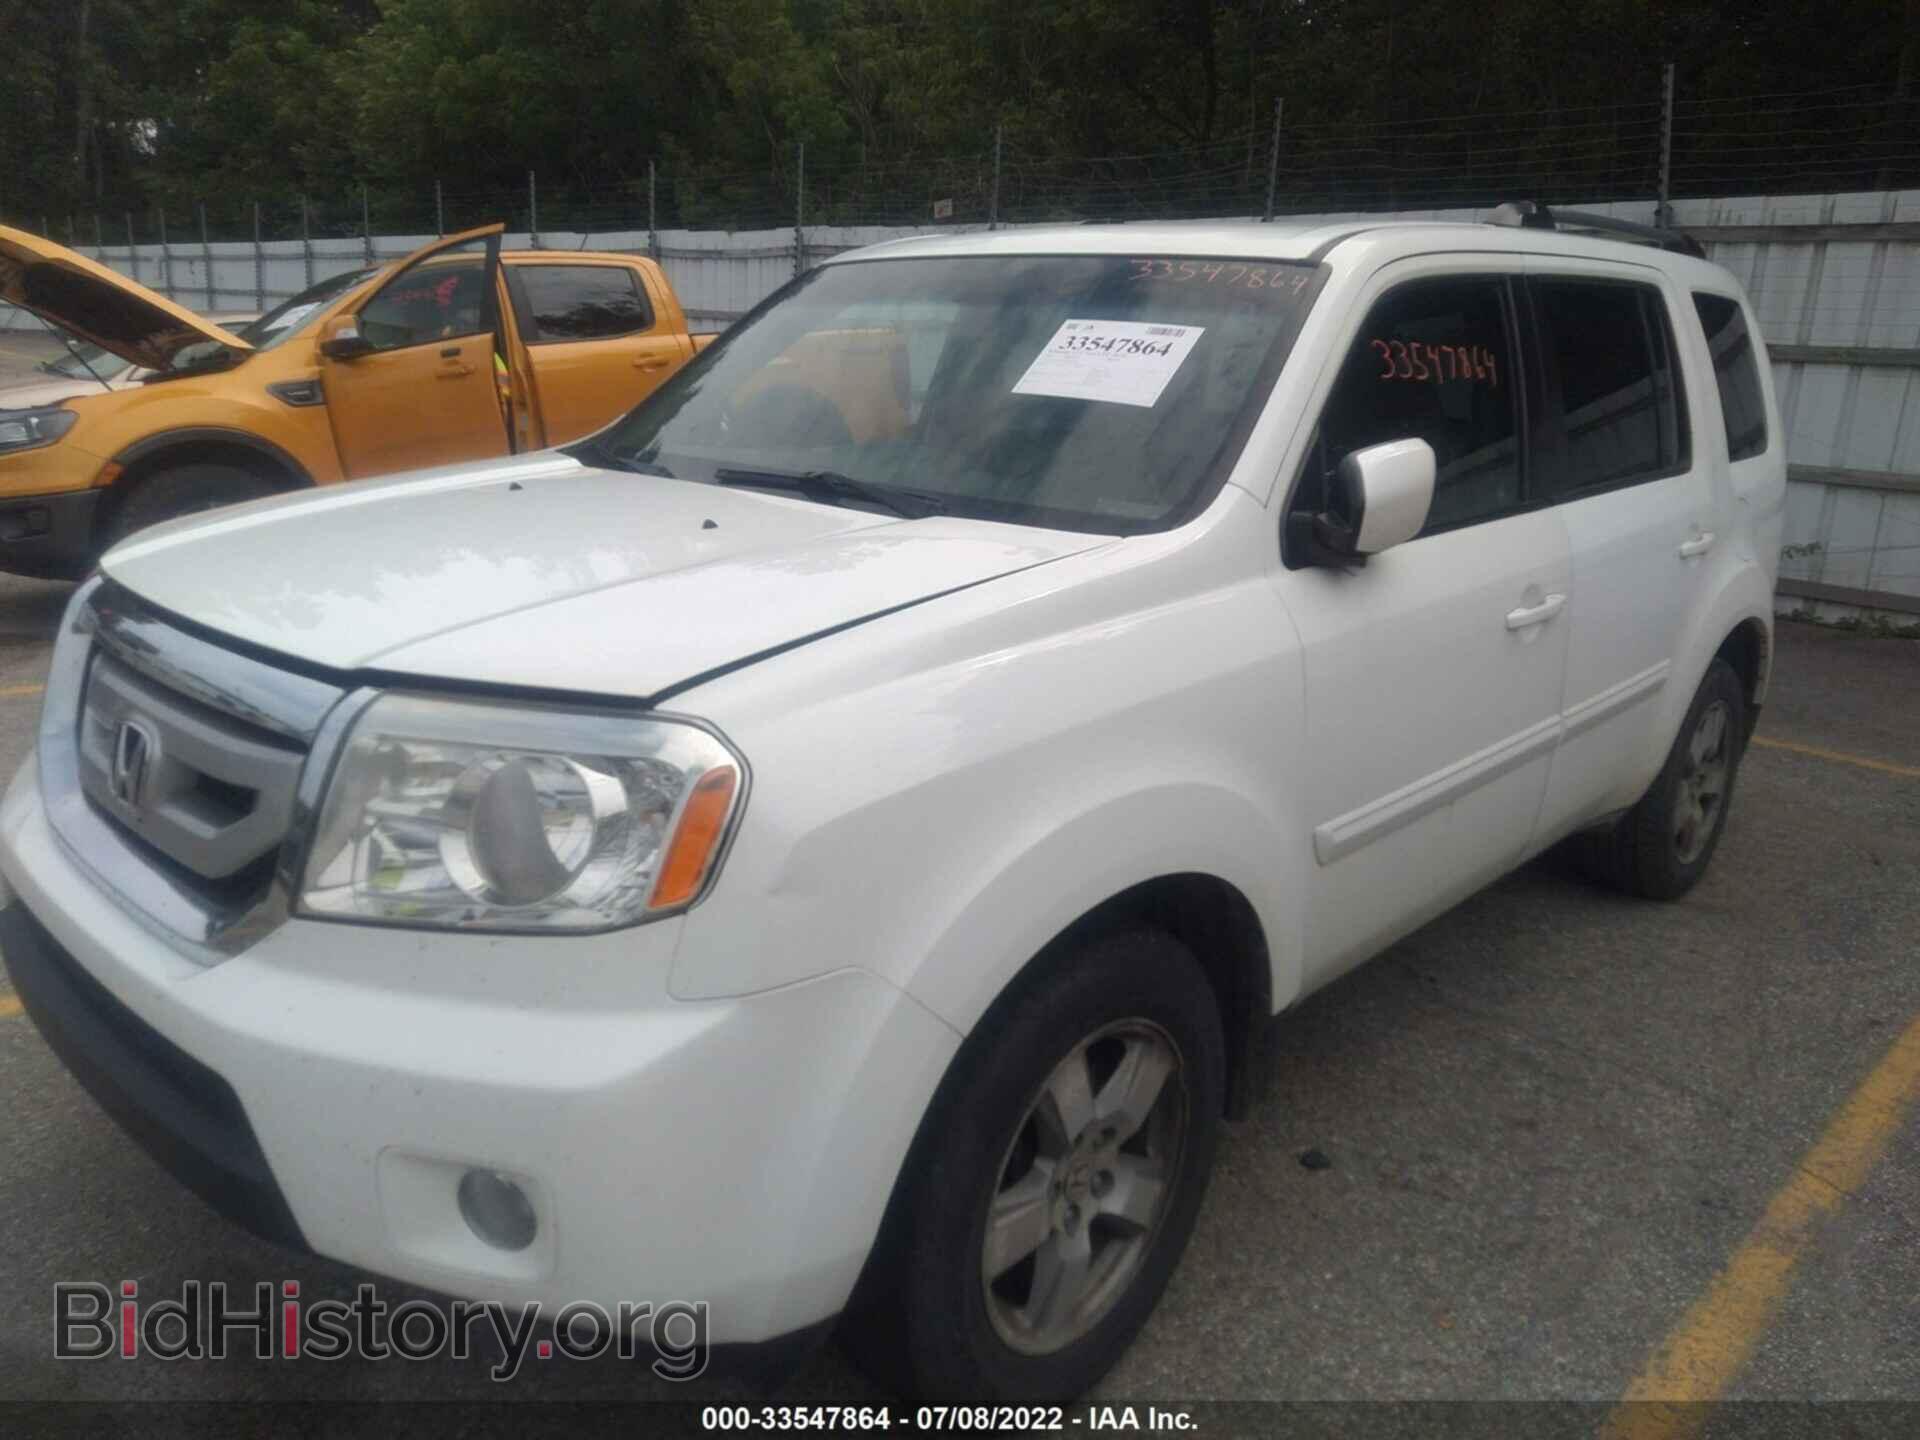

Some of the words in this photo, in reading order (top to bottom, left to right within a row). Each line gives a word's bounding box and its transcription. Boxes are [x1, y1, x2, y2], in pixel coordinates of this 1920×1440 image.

[1129, 258, 1309, 295] 33547864
[1058, 335, 1174, 357] 33547864
[1370, 338, 1498, 386] 33547864
